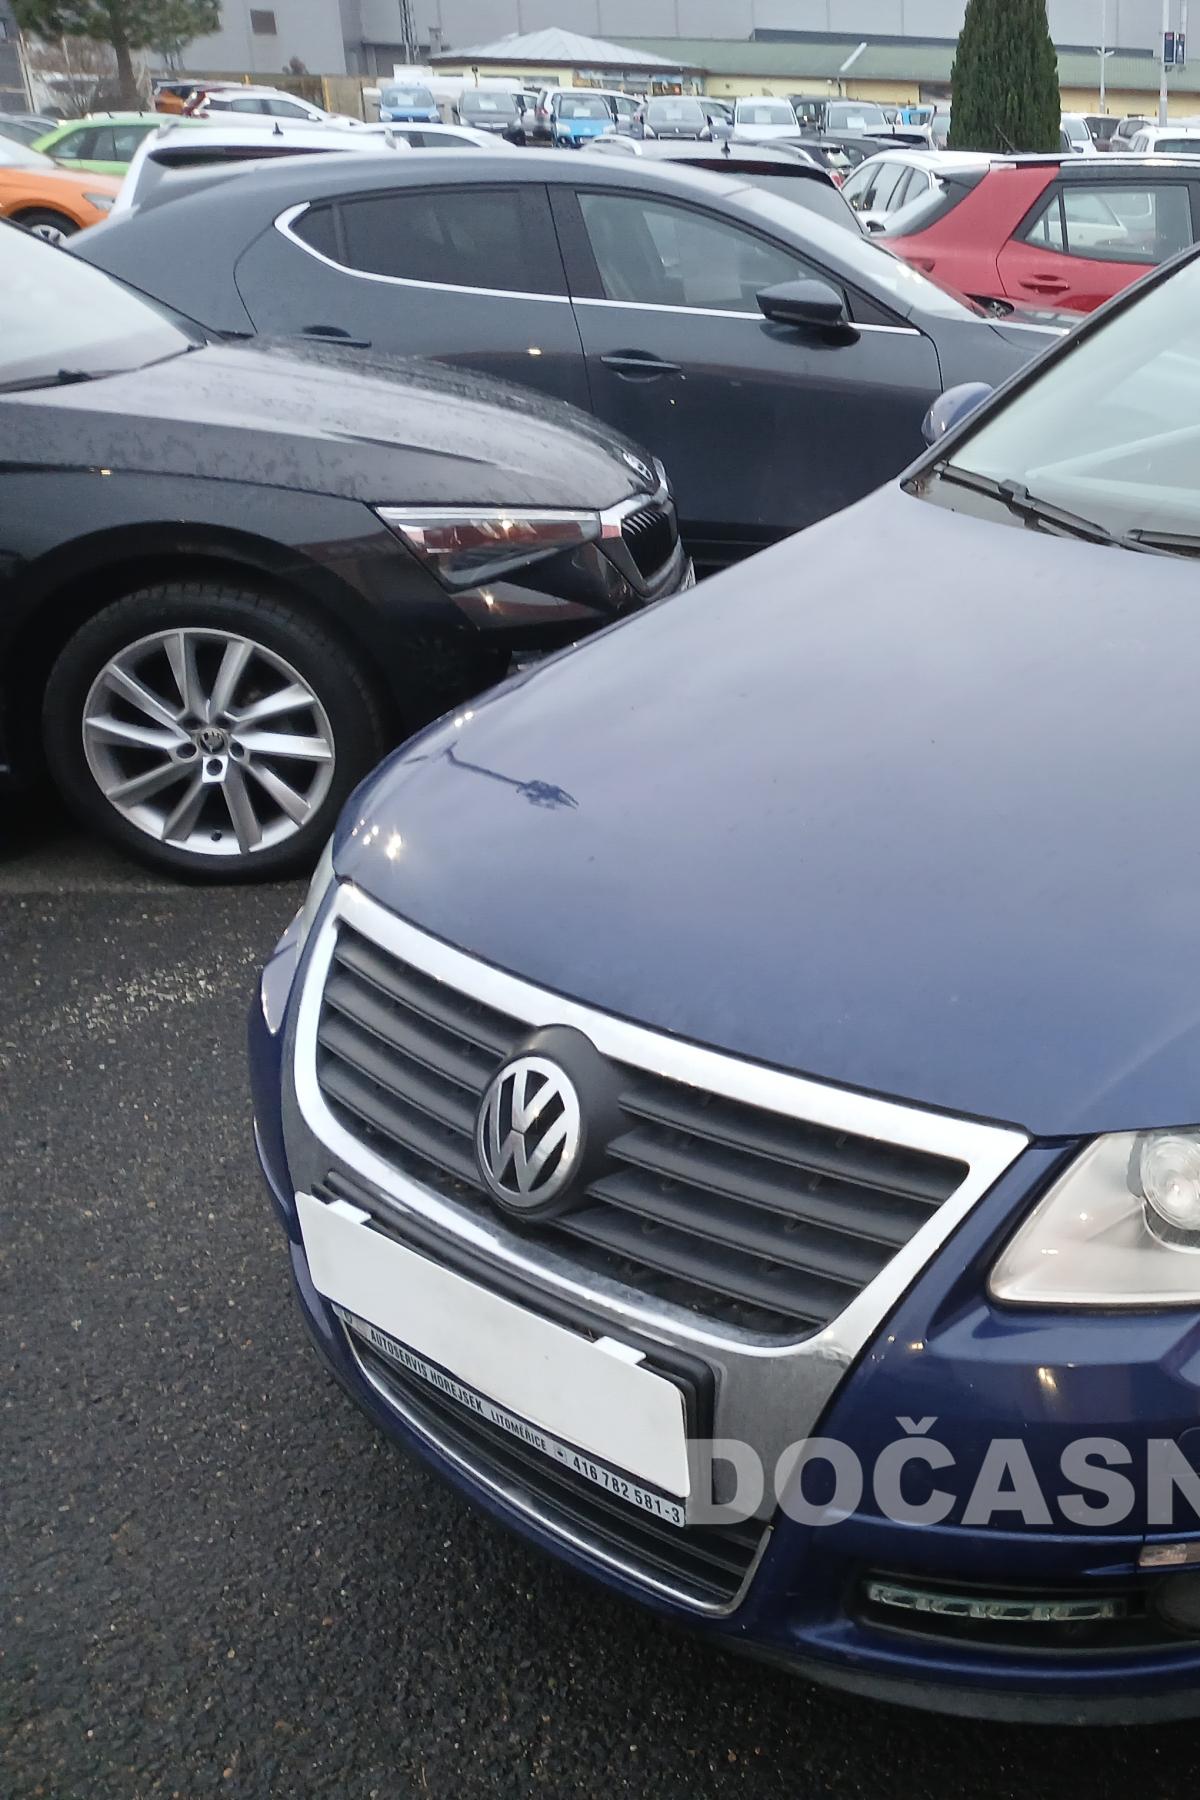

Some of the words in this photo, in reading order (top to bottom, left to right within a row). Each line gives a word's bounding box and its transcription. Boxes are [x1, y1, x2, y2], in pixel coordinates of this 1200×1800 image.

[479, 1056, 581, 1208] VW
[370, 1329, 427, 1378] AUTOSERVIS
[573, 1455, 598, 1481] 416
[601, 1471, 629, 1499] 782
[634, 1489, 680, 1523] 581-3
